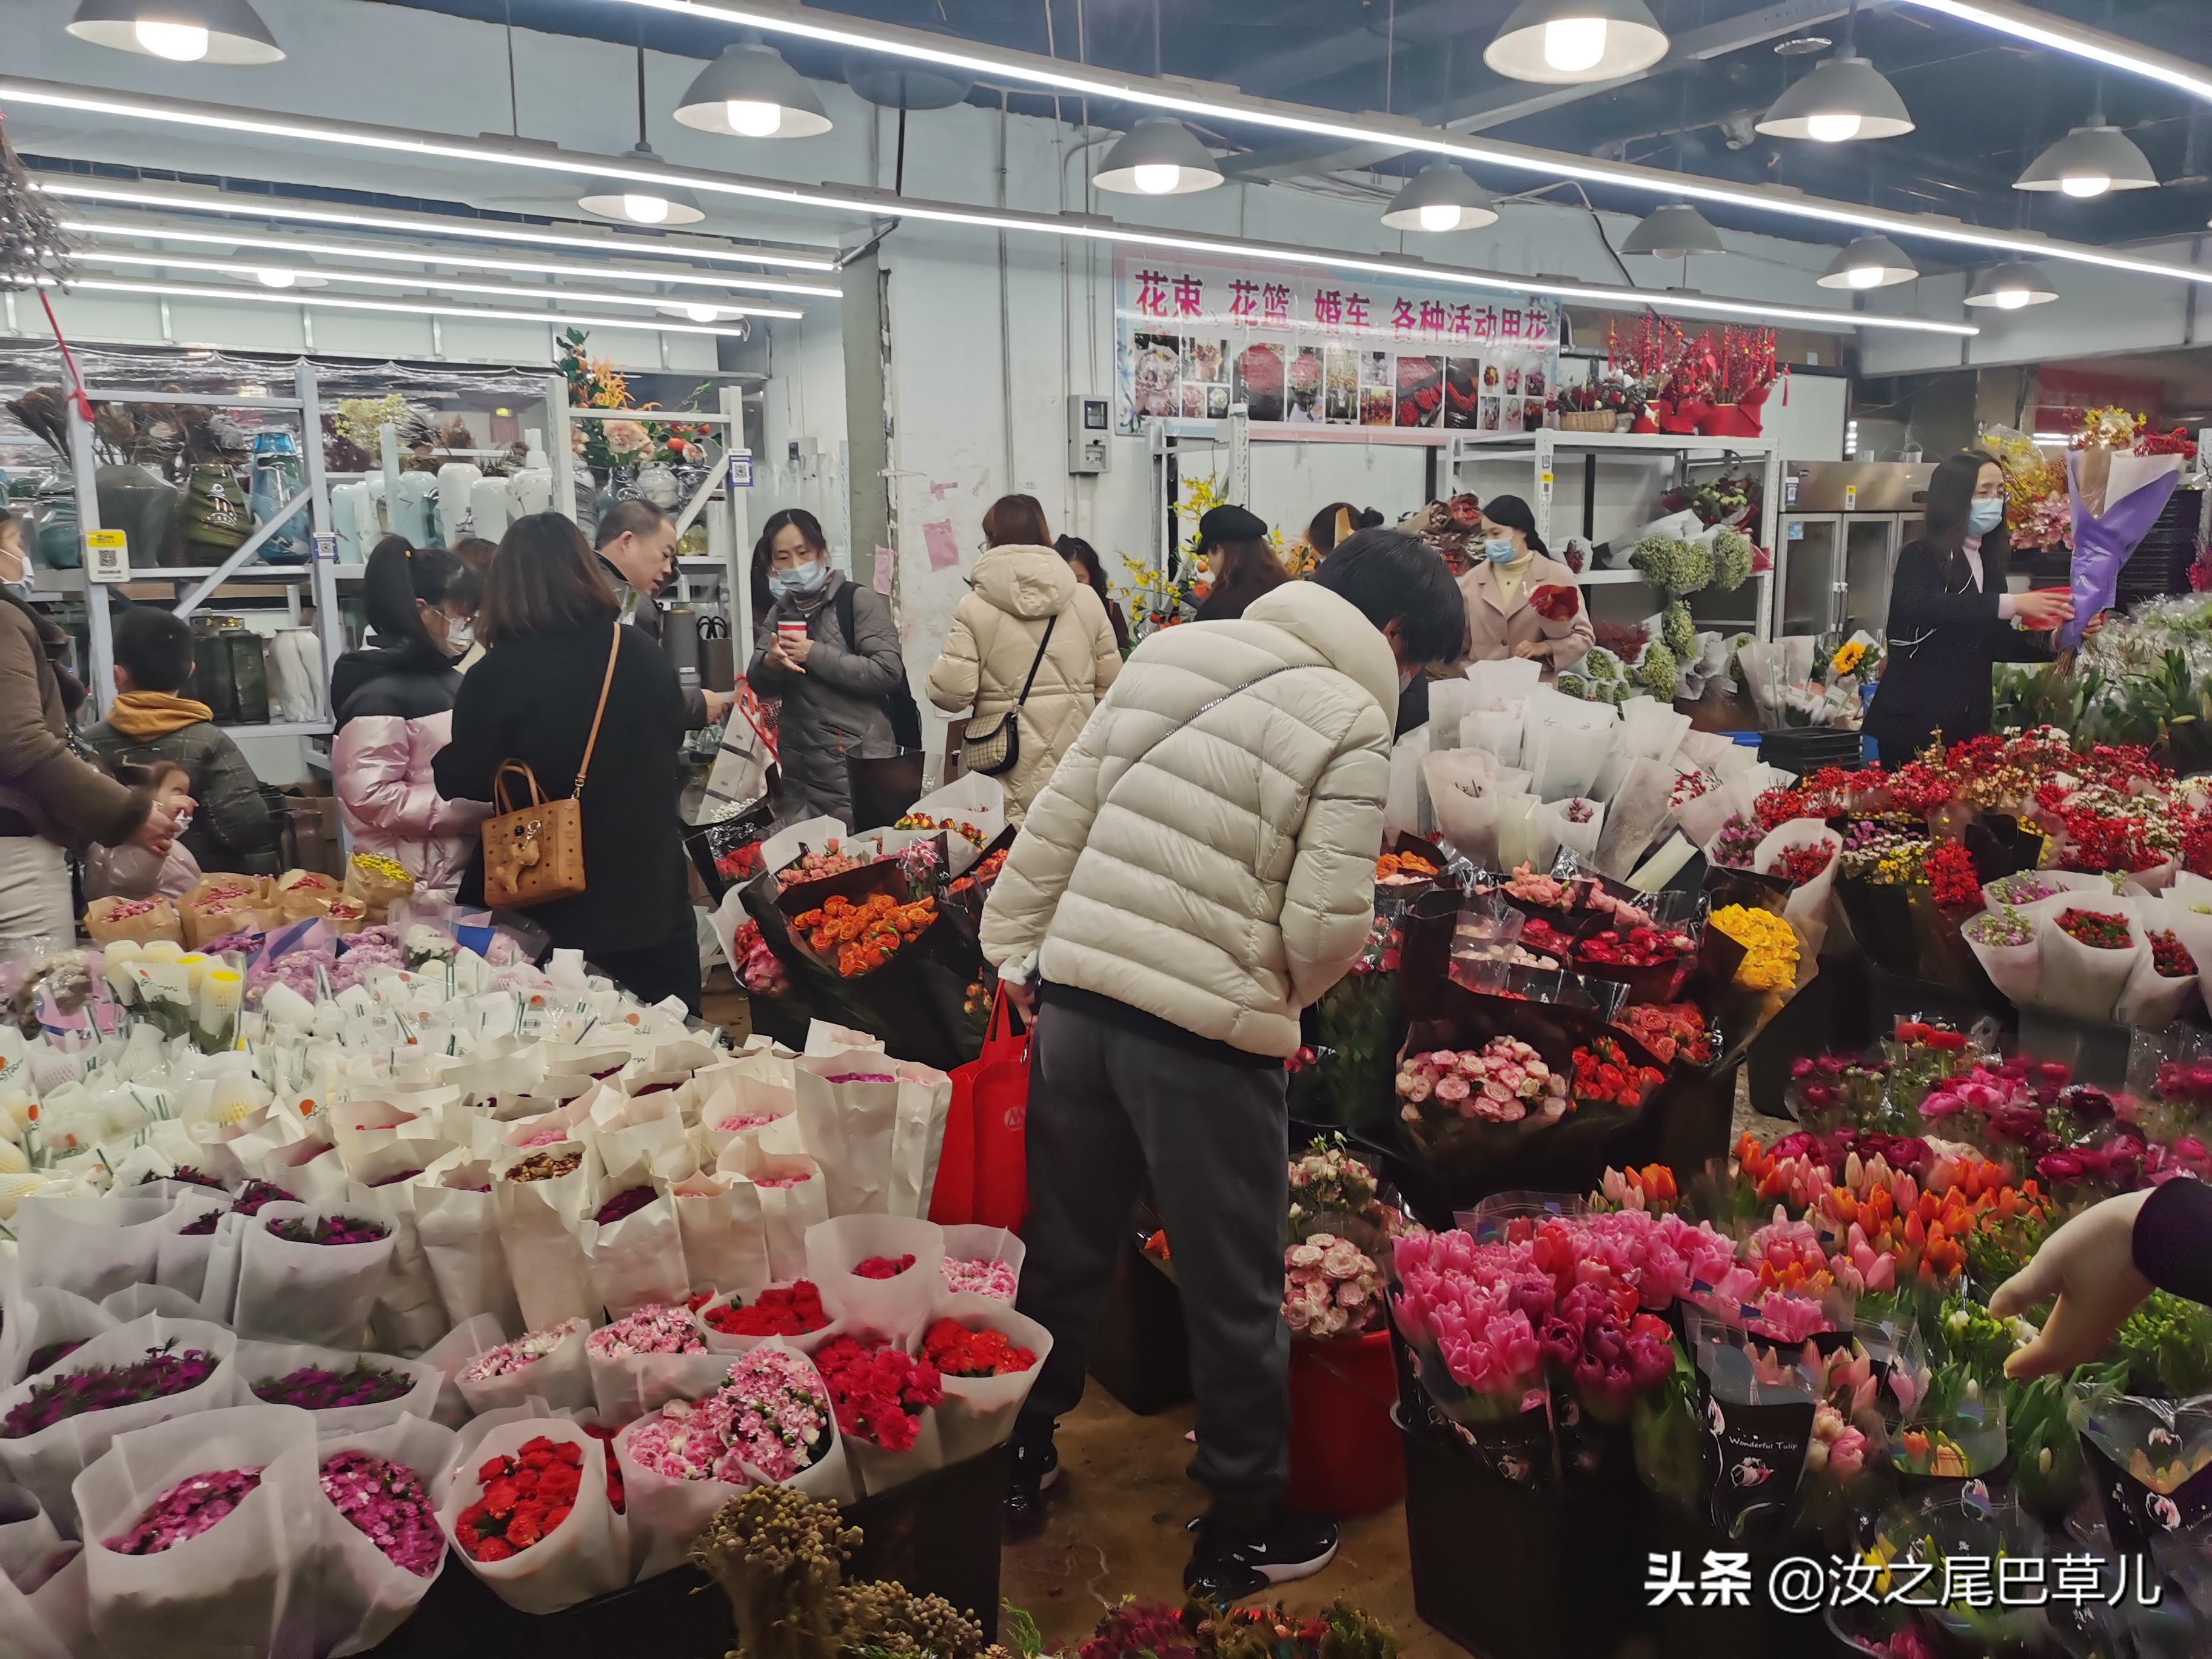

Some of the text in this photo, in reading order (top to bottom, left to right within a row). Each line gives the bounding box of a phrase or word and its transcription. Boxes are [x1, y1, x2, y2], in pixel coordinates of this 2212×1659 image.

[1134, 269, 1204, 318] 花束
[1729, 1435, 1798, 1450] Wonderful Tulip
